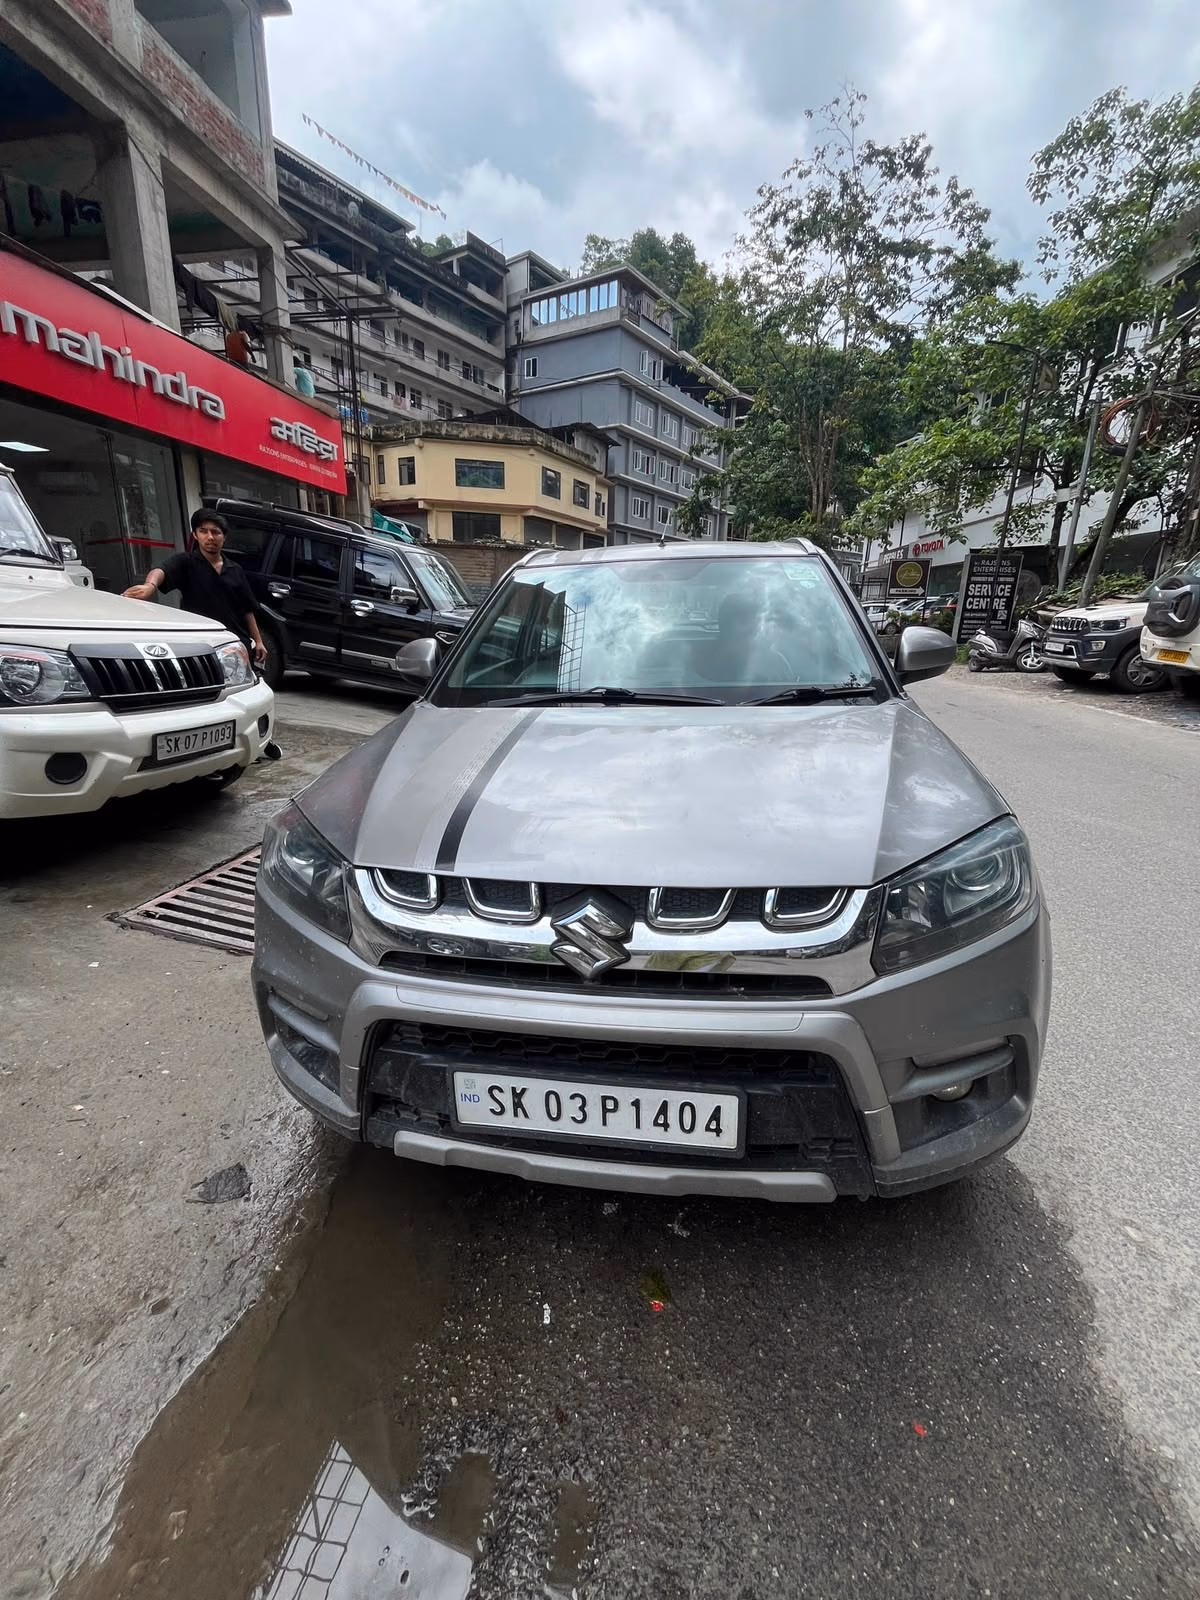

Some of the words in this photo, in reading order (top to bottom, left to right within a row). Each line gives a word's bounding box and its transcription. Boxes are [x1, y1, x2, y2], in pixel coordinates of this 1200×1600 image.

[1, 301, 226, 420] mahindra
[921, 539, 945, 553] TOYOTA
[166, 737, 181, 754] SK
[184, 733, 198, 750] 07
[460, 1092, 481, 1104] IND
[487, 1084, 530, 1119] SK
[544, 1089, 589, 1125] 03
[600, 1094, 724, 1138] P1404
